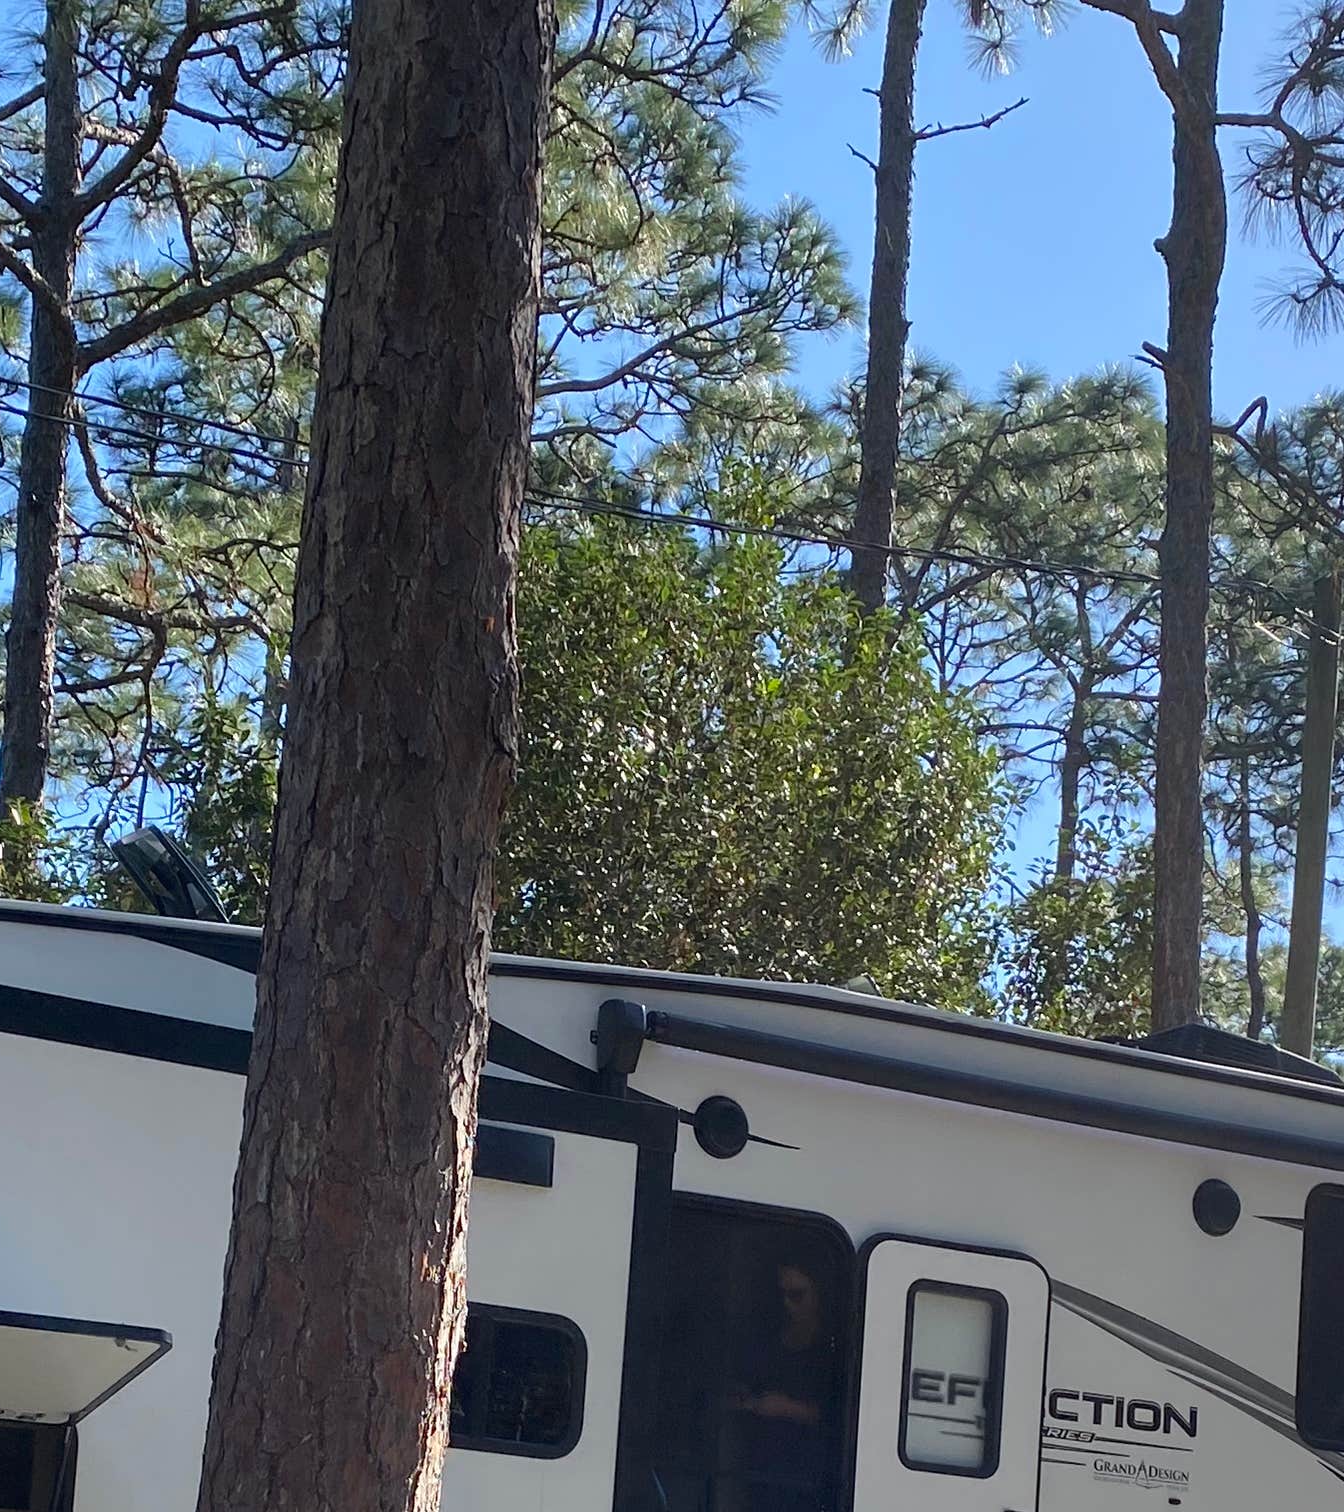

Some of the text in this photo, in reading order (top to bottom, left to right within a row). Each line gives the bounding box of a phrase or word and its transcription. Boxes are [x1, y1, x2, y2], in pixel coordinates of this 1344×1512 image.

[1049, 1388, 1198, 1438] CTION
[1093, 1459, 1137, 1476] GRAND
[1148, 1465, 1190, 1483] DESIGN
